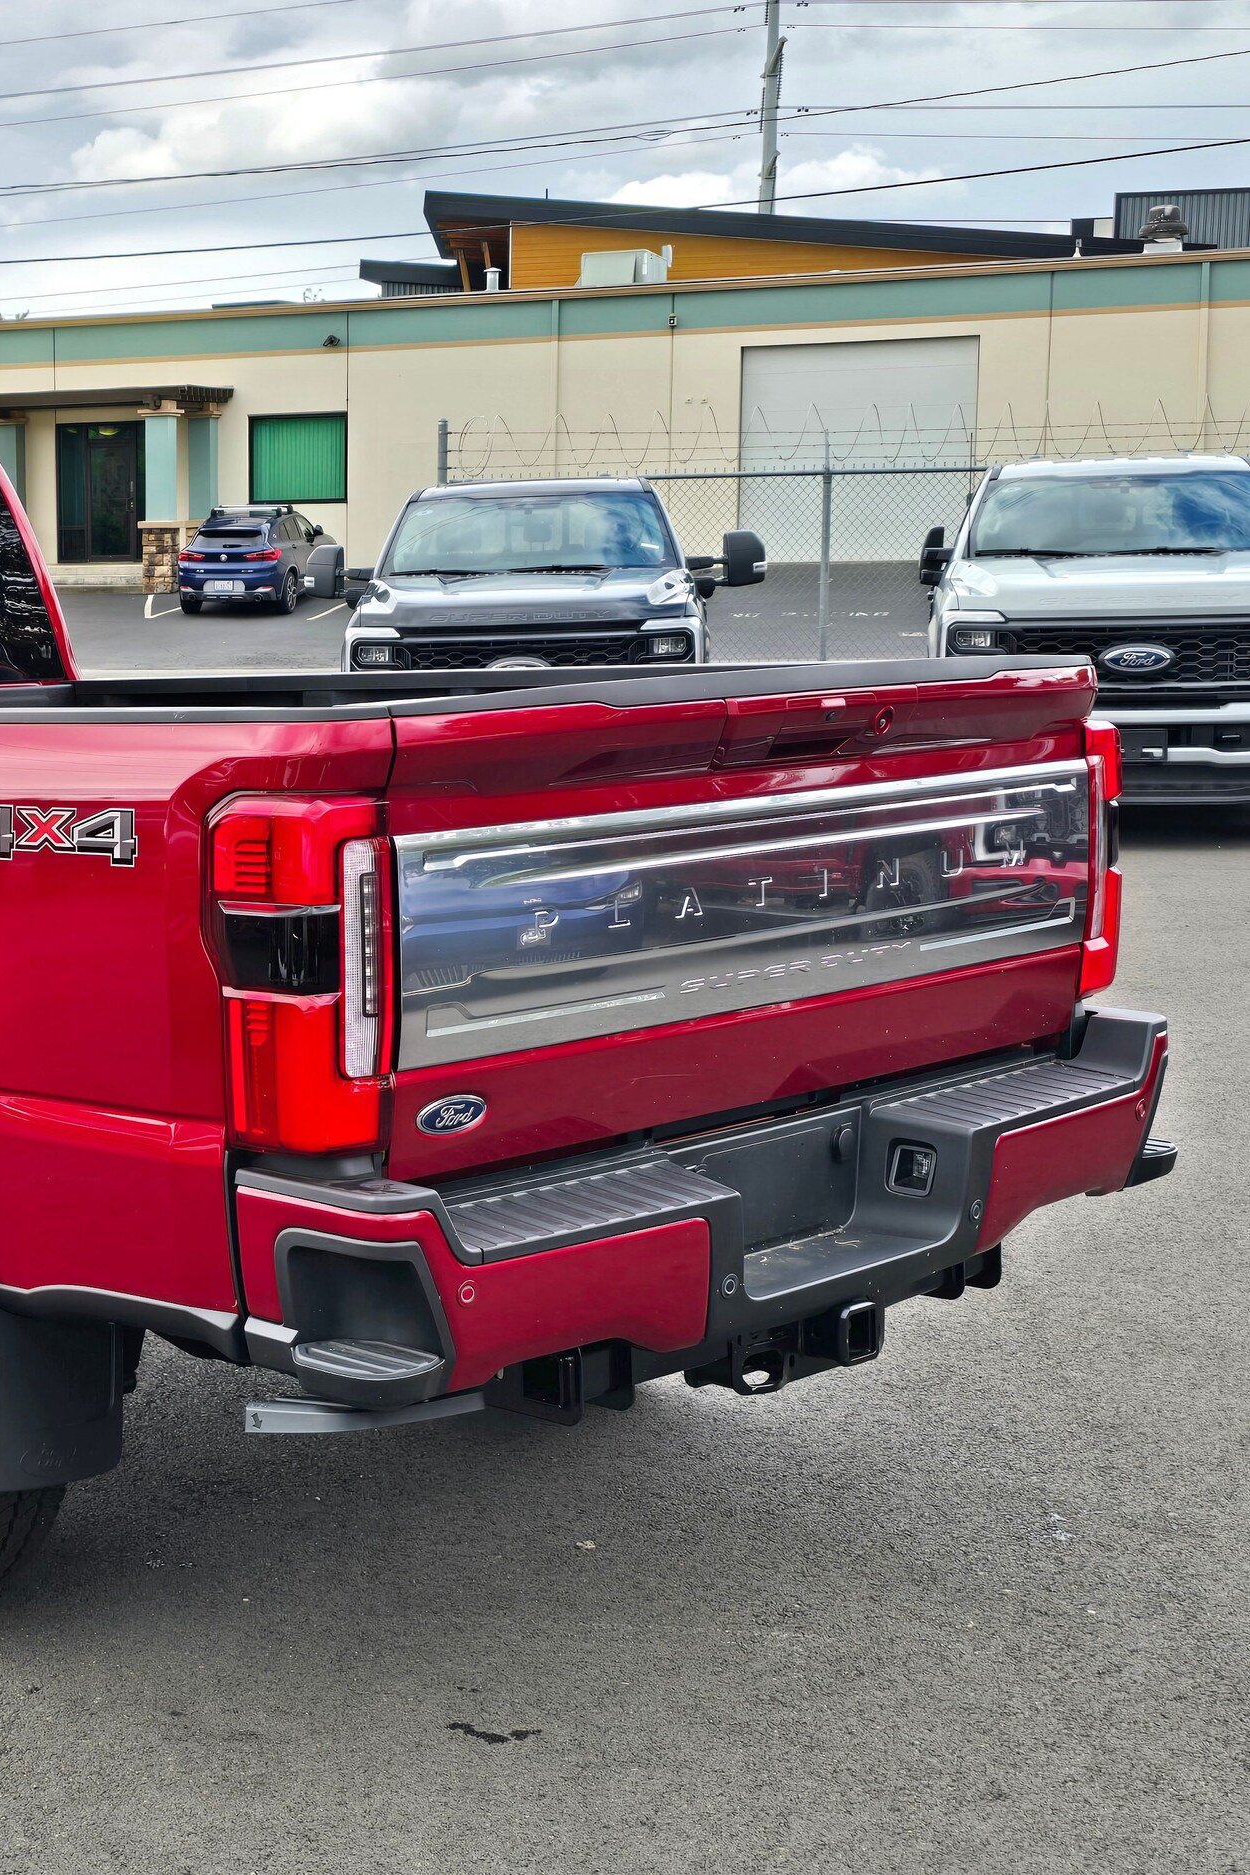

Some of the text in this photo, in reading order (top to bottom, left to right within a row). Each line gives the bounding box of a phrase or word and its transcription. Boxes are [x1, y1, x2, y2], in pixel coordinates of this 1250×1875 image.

[429, 610, 611, 624] SUPER DUTY
[1120, 651, 1156, 666] Ford
[527, 838, 1027, 941] PLATINUM
[680, 941, 913, 994] SUPER DUTY
[435, 1103, 475, 1129] Ford
